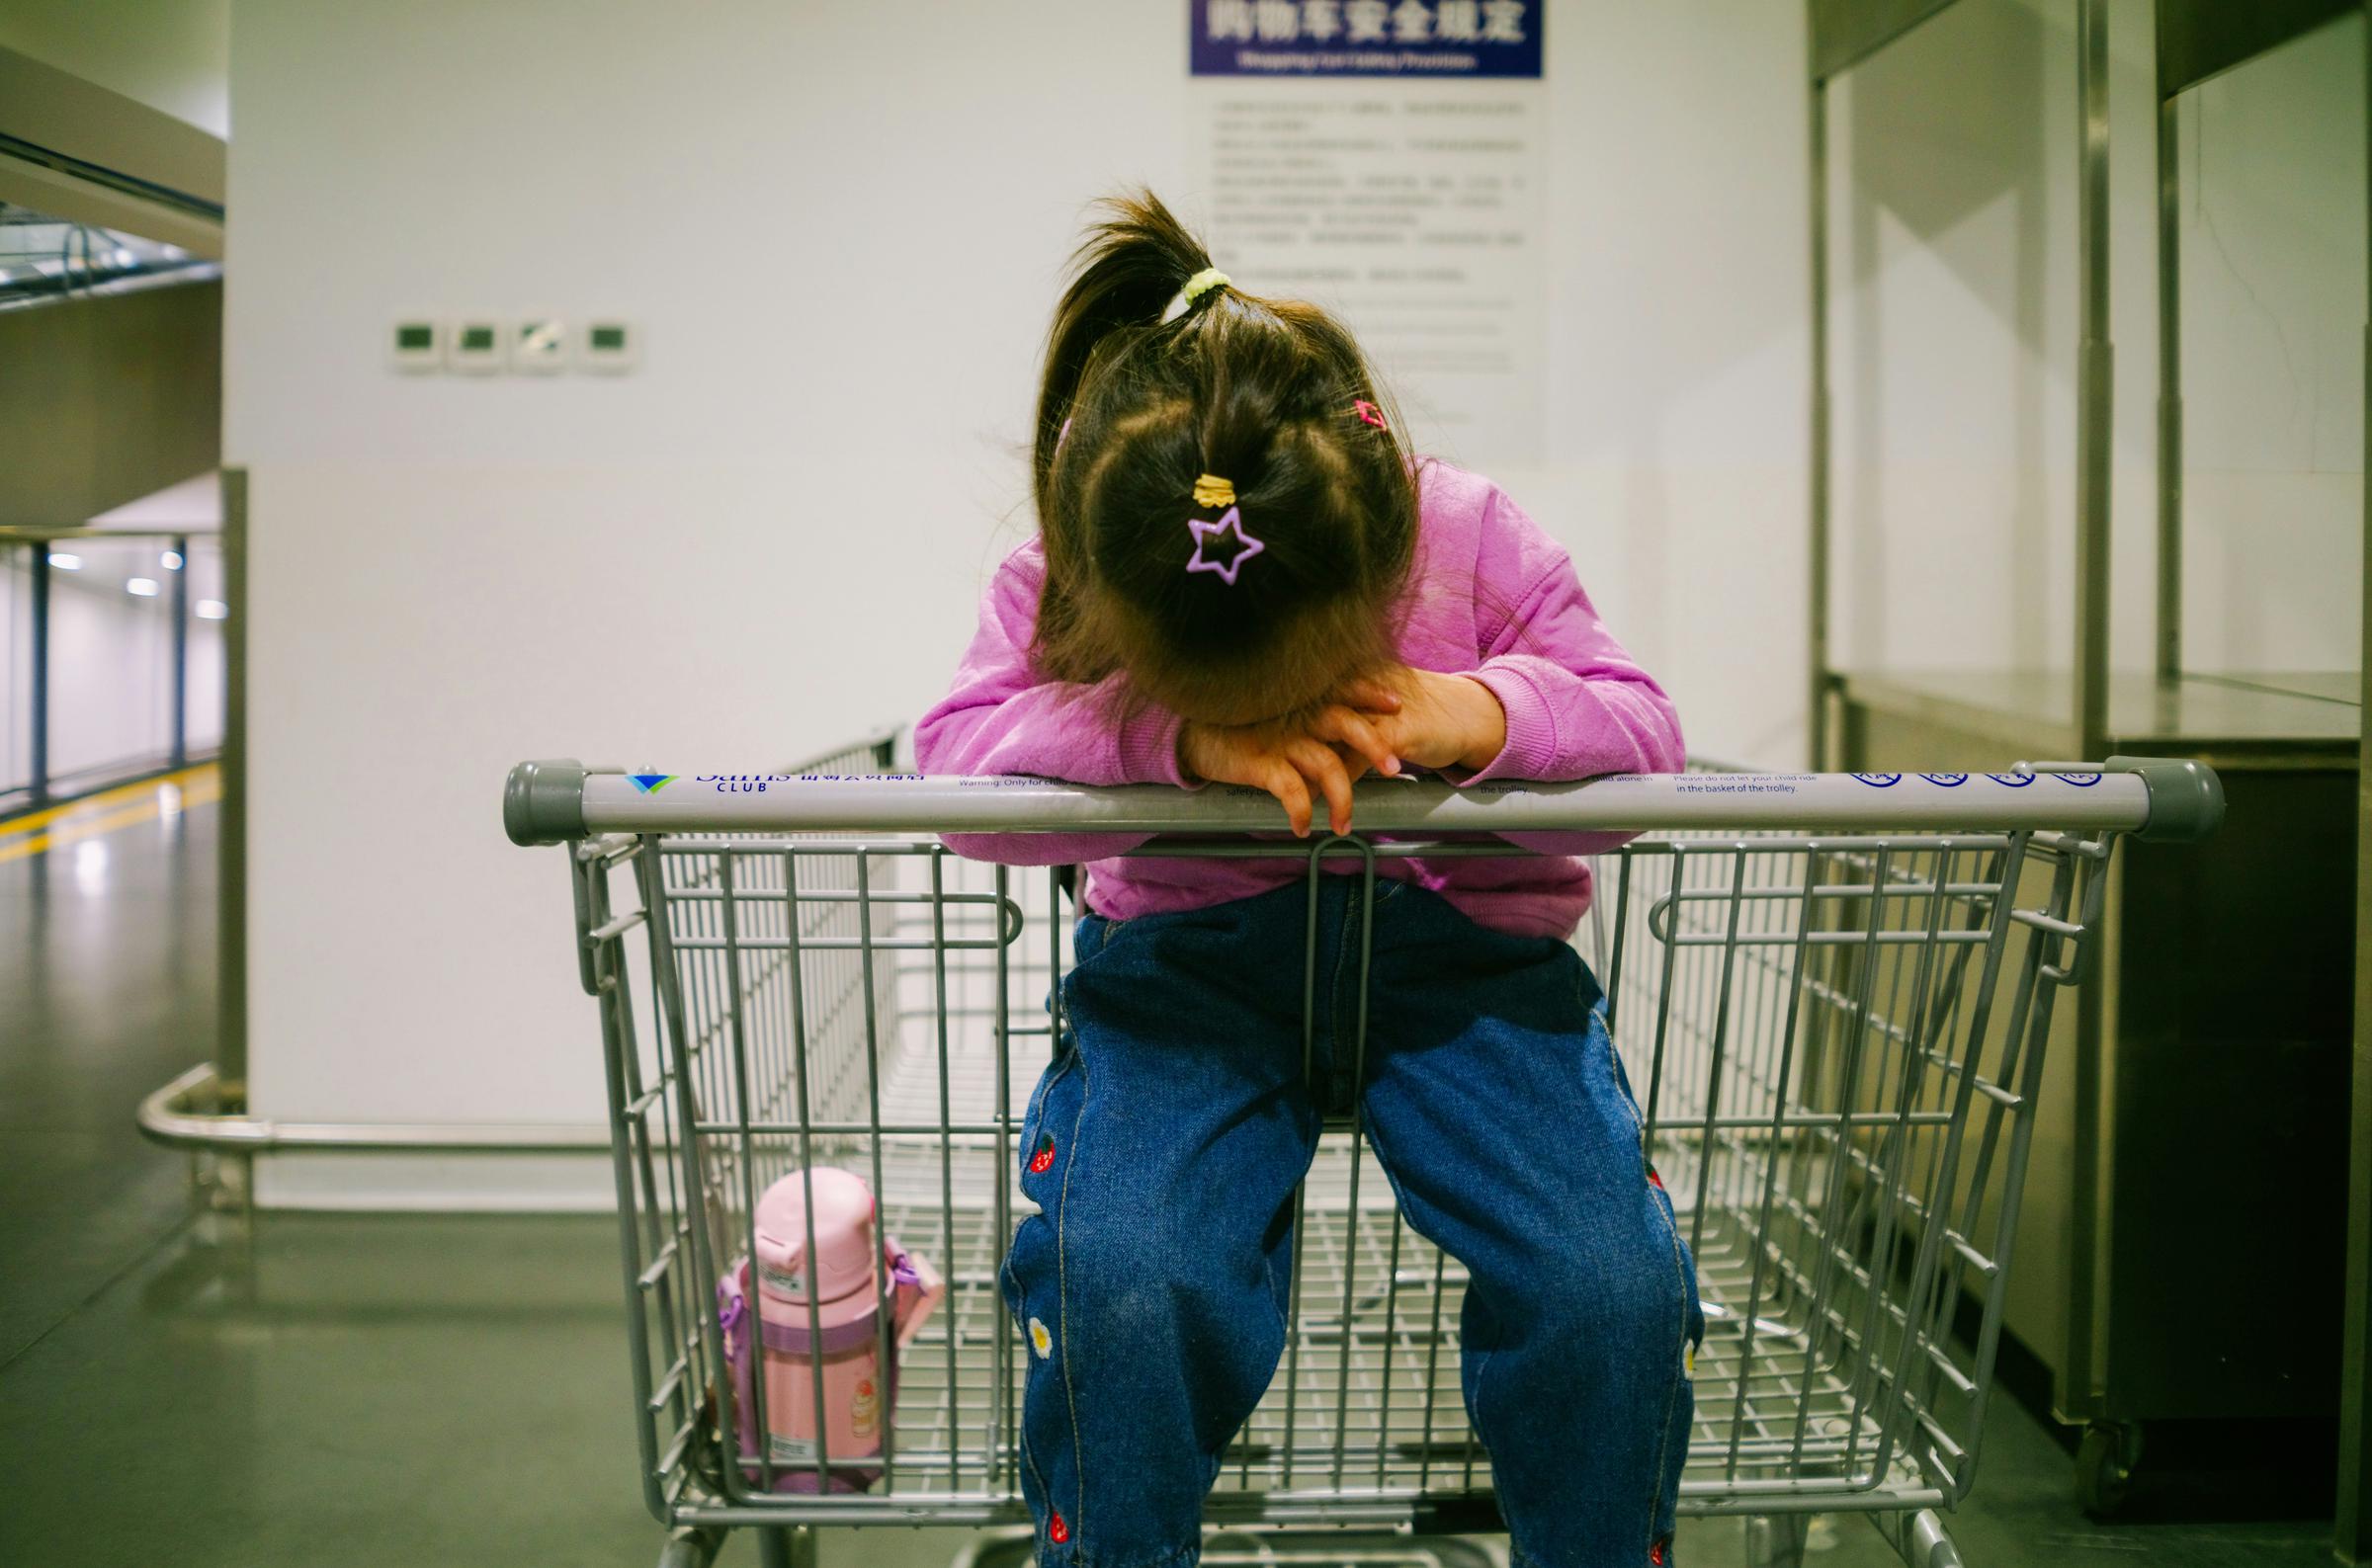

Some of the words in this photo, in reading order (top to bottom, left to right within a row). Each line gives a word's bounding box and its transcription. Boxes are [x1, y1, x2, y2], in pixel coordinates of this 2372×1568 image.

[1004, 779, 1027, 787] Only
[717, 783, 767, 792] CLUB
[1481, 785, 1496, 794] the
[1705, 784, 1735, 792] basket
[1737, 784, 1746, 792] of
[1748, 784, 1764, 792] the
